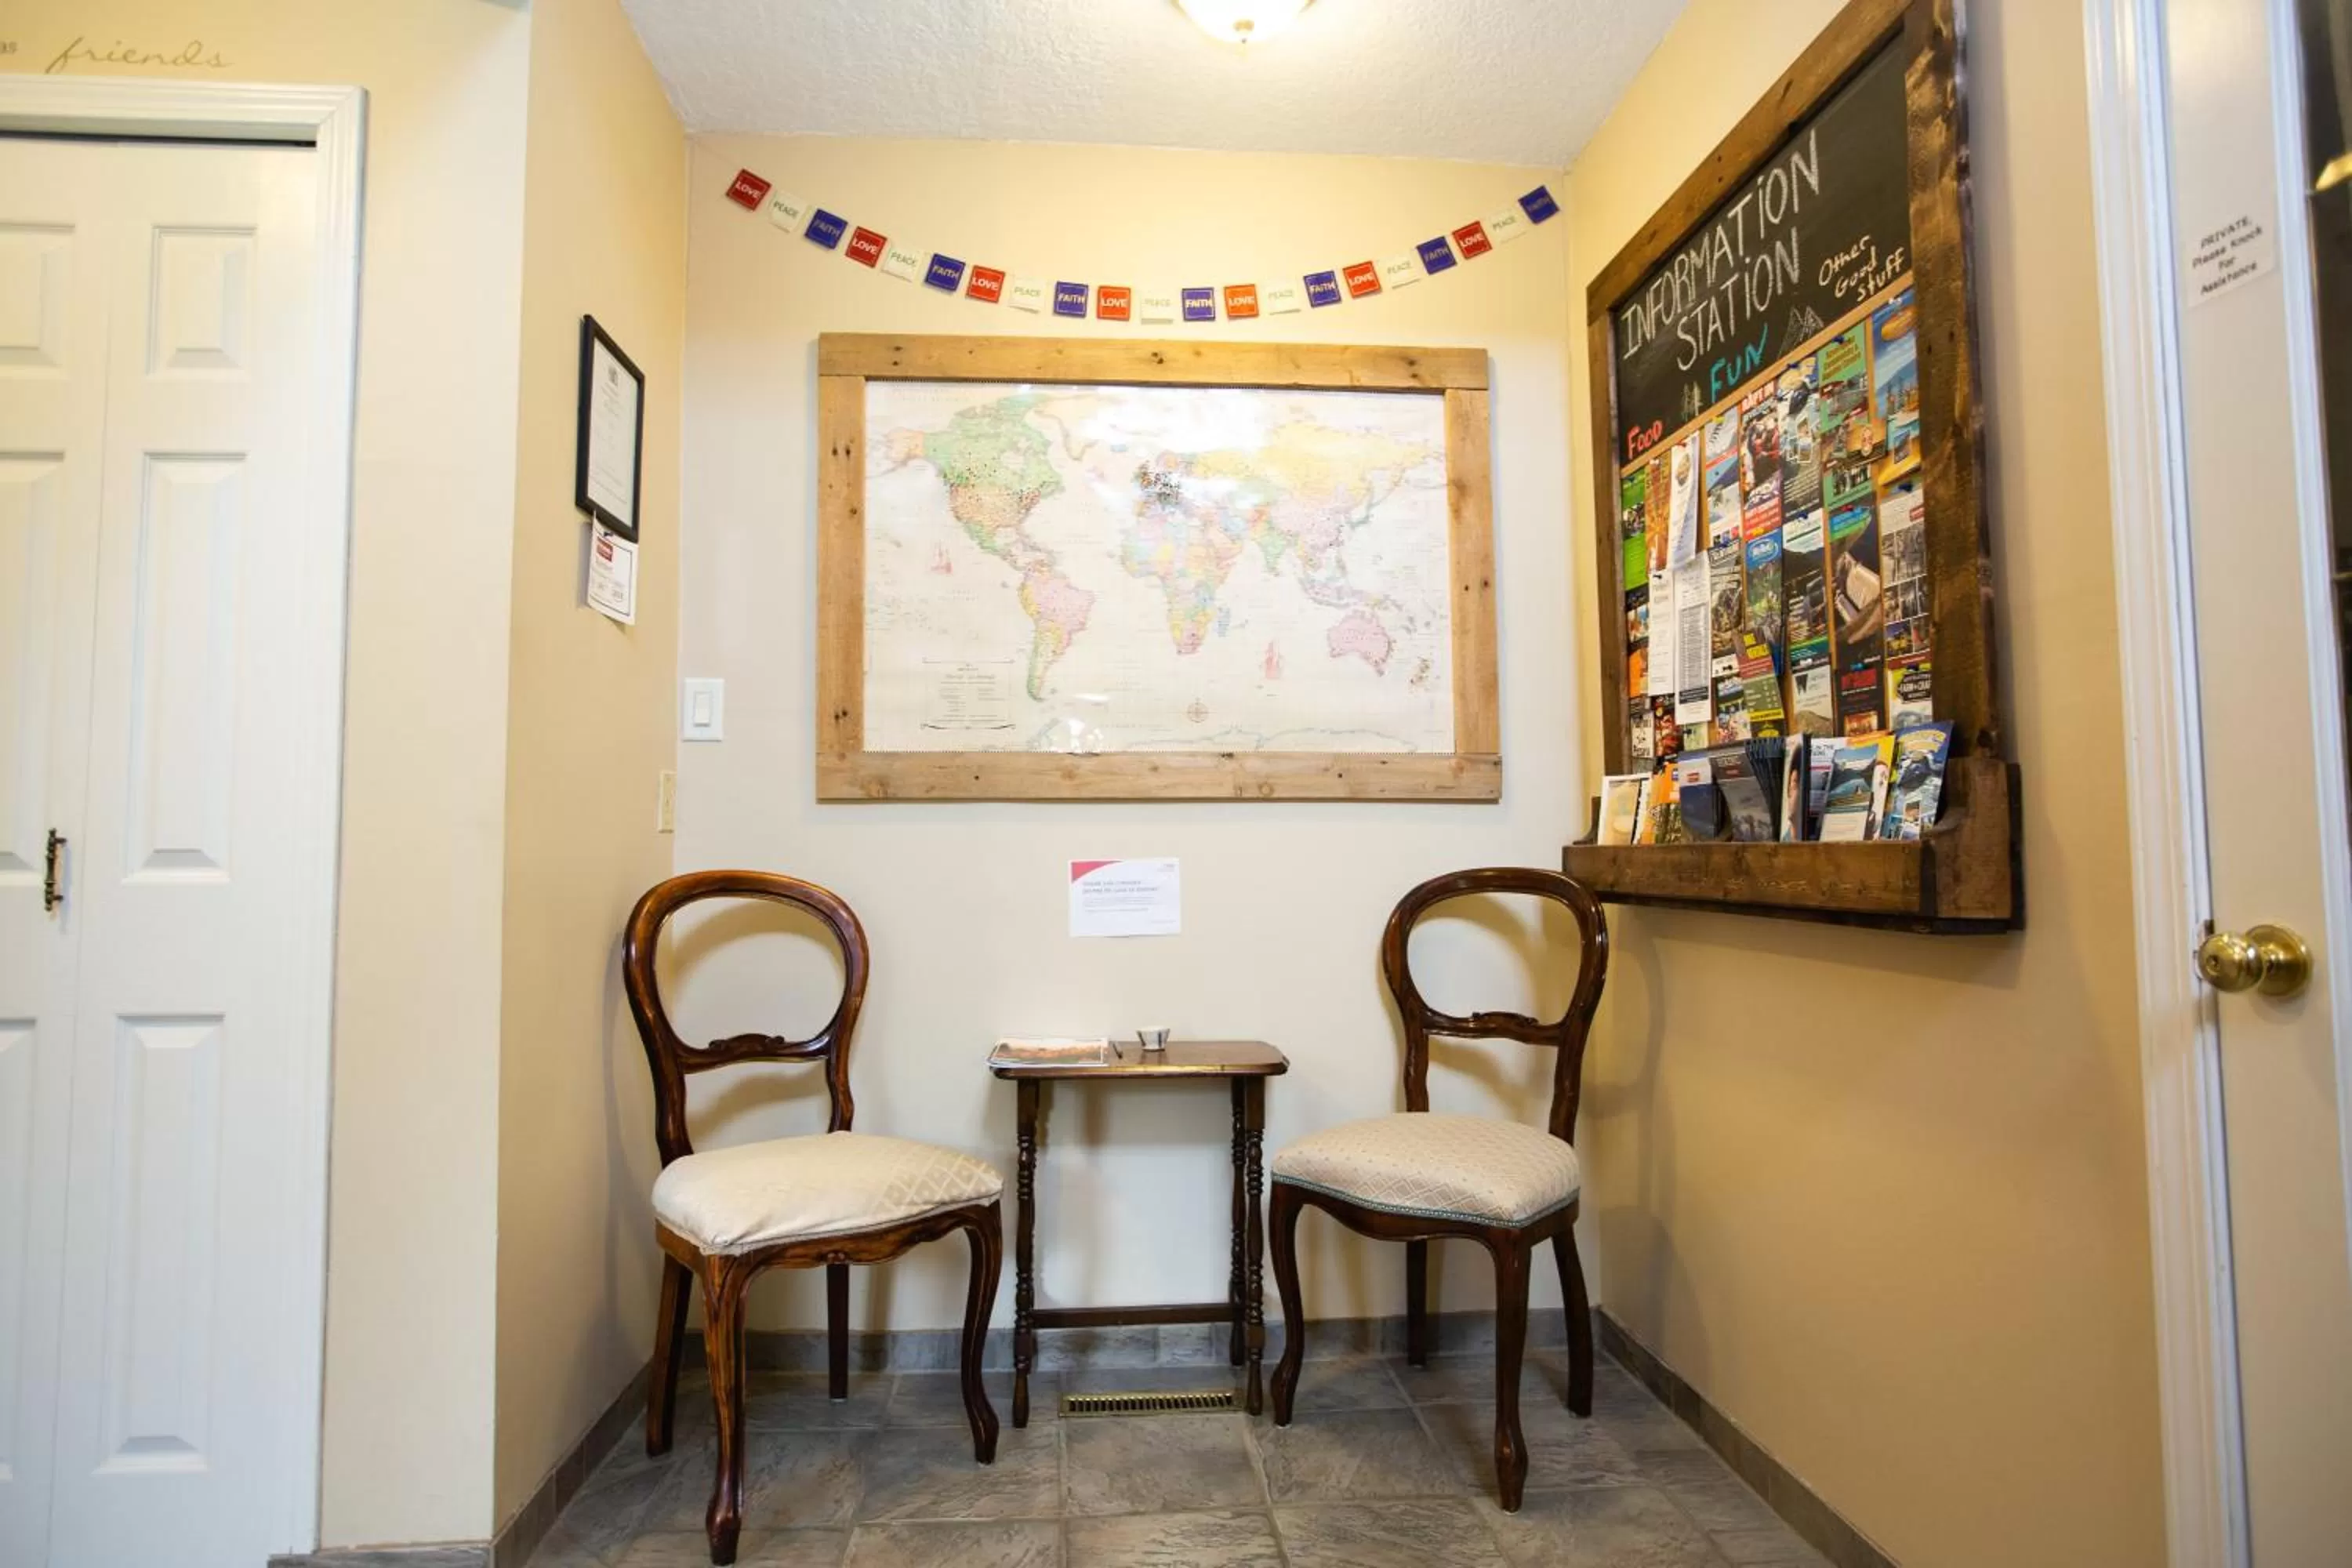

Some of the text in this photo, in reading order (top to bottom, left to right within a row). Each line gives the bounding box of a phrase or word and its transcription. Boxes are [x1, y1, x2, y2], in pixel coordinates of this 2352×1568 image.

[45, 36, 235, 74] friends
[735, 180, 762, 199] LOVE
[773, 200, 800, 219] PEACE
[814, 219, 840, 238] FAITH
[852, 238, 880, 256] LOVE
[891, 251, 916, 267] PEACE
[931, 263, 960, 279] FAITH
[971, 276, 999, 291] LOVE
[1014, 285, 1041, 297] PEACE
[1058, 292, 1086, 305] FAITH
[1101, 298, 1127, 308] LOVE
[1185, 299, 1213, 308] FAITH
[1229, 295, 1255, 307] LOVE
[1309, 280, 1336, 293] FAITH
[1348, 271, 1374, 286] LOVE
[1387, 260, 1412, 275] PEACE
[1425, 245, 1450, 262] FAITH
[1460, 233, 1486, 249] LOVE
[1492, 215, 1517, 231] PEACE
[2192, 246, 2227, 270] Please
[1710, 323, 1769, 404] FUN
